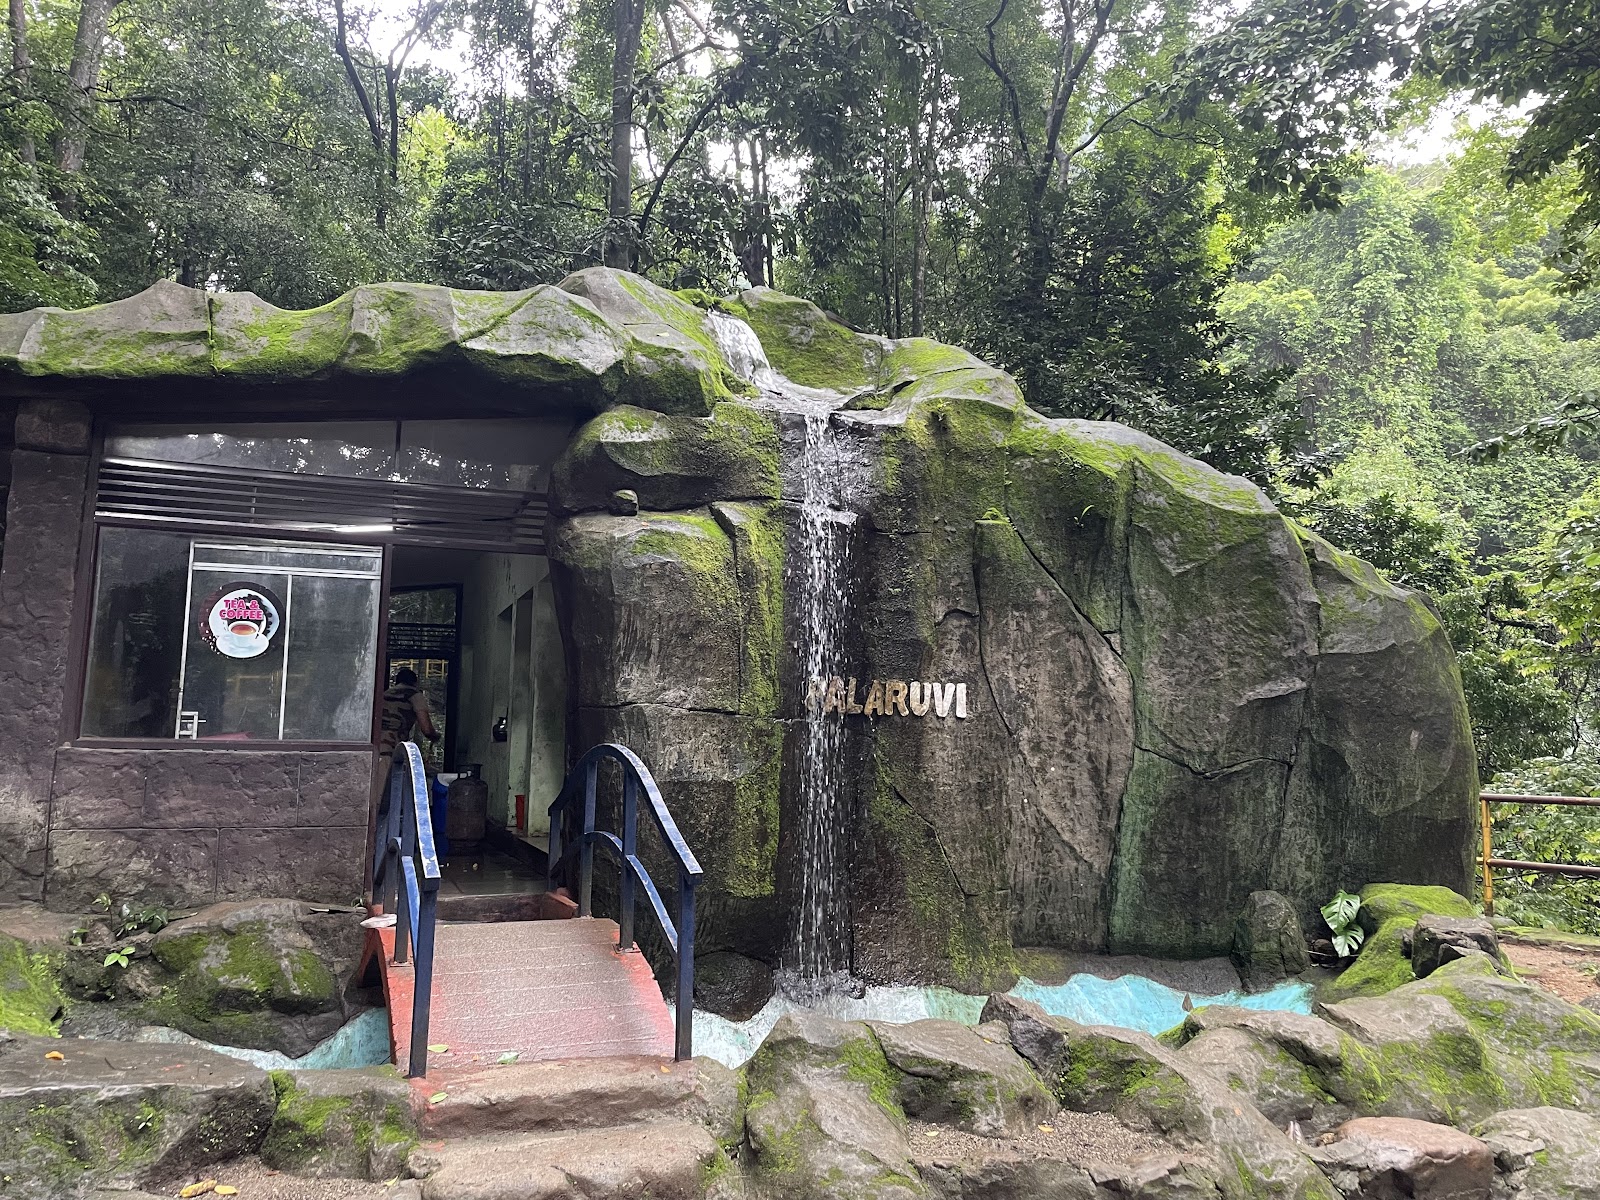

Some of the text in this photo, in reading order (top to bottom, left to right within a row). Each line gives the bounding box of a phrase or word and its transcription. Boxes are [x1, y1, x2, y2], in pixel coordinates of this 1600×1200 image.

[223, 599, 260, 610] TEA &
[219, 609, 264, 620] COFFEE
